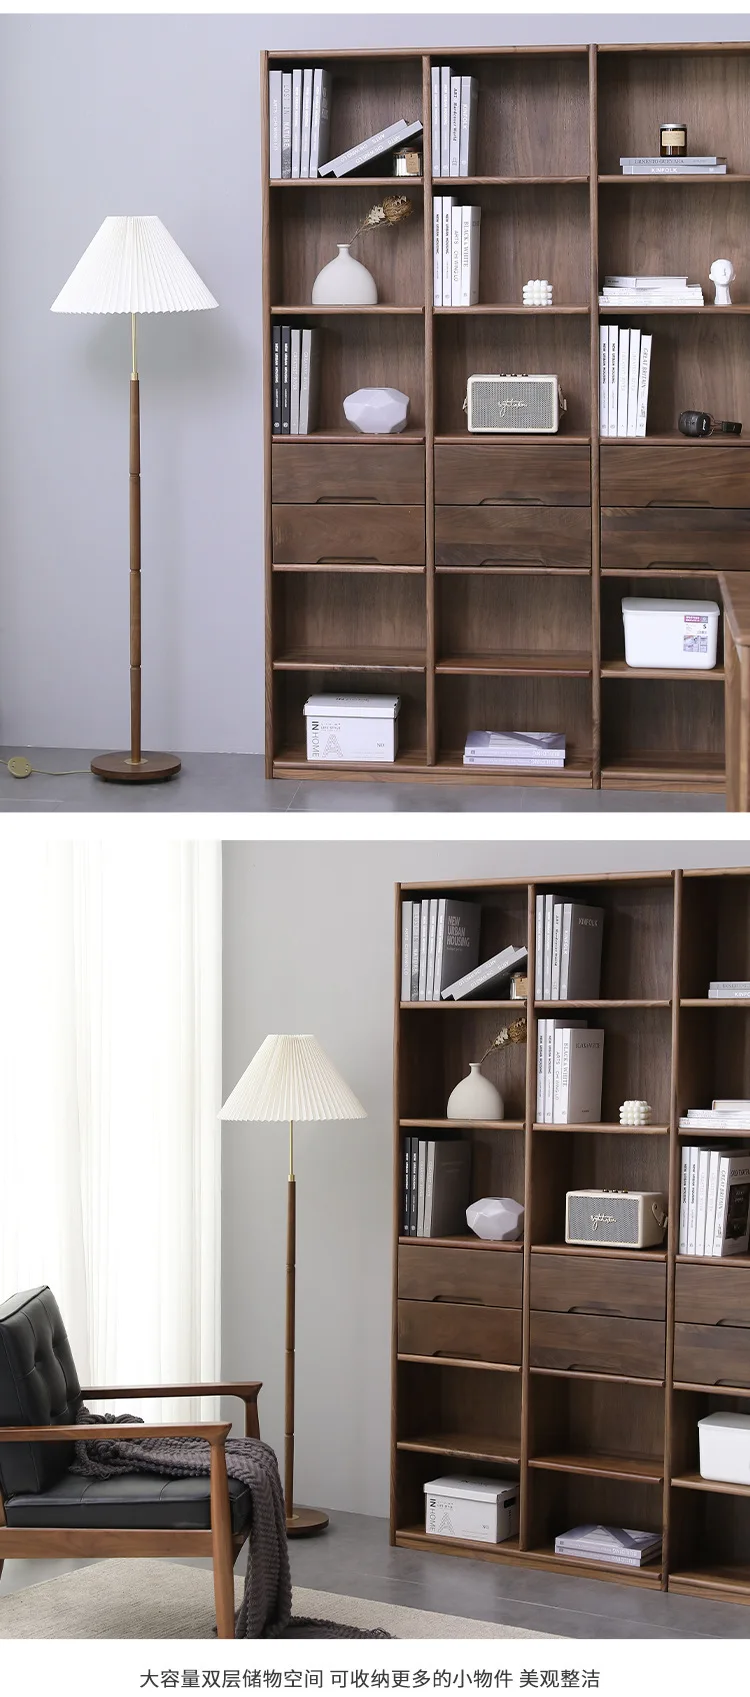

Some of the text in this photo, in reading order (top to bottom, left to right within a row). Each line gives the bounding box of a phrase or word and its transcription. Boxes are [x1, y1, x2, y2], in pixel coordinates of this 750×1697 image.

[312, 721, 320, 757] IN HOME
[447, 915, 461, 926] NEW
[447, 925, 466, 937] URBAN
[446, 935, 470, 947] HOUSING
[429, 1498, 437, 1532] IN HOME
